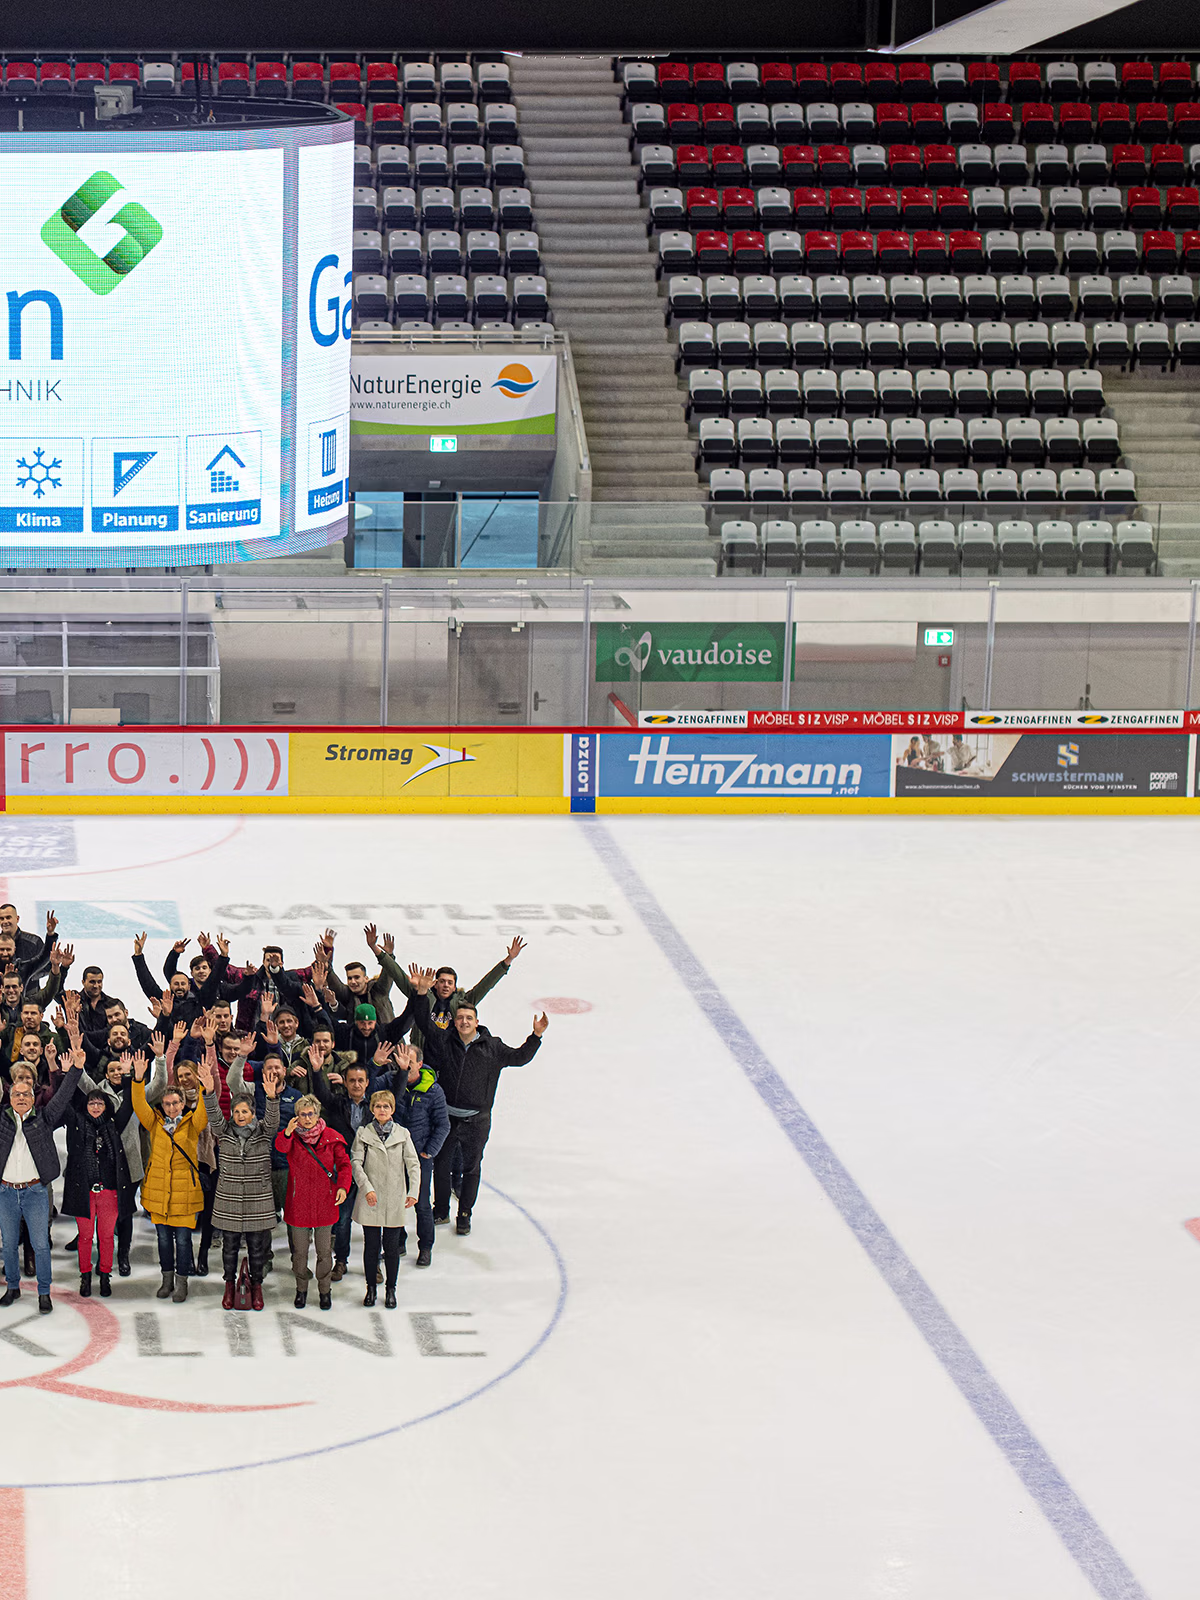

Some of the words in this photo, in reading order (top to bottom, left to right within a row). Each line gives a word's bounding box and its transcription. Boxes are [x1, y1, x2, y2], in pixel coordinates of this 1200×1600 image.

[350, 374, 482, 399] NaturEnergie
[349, 399, 451, 411] www.naturenergie.ch
[313, 489, 341, 509] Heizung
[16, 512, 62, 527] Klima
[102, 512, 168, 528] Planung
[188, 507, 259, 524] Sanierung
[657, 642, 772, 665] vaudoise
[677, 715, 746, 725] ZENGAFFINEN
[753, 712, 795, 725] MÖBEL
[823, 714, 849, 725] VISP
[862, 712, 904, 725] MÖBEL
[933, 714, 959, 725] VISP
[1003, 715, 1072, 725] ZENGAFFINEN
[1110, 715, 1179, 724] ZENGAFFINEN
[325, 743, 413, 765] Stromag
[576, 736, 590, 793] Lonza
[835, 785, 860, 795] .net
[213, 903, 613, 921] GATTLEN
[215, 923, 624, 936] METLLBAU
